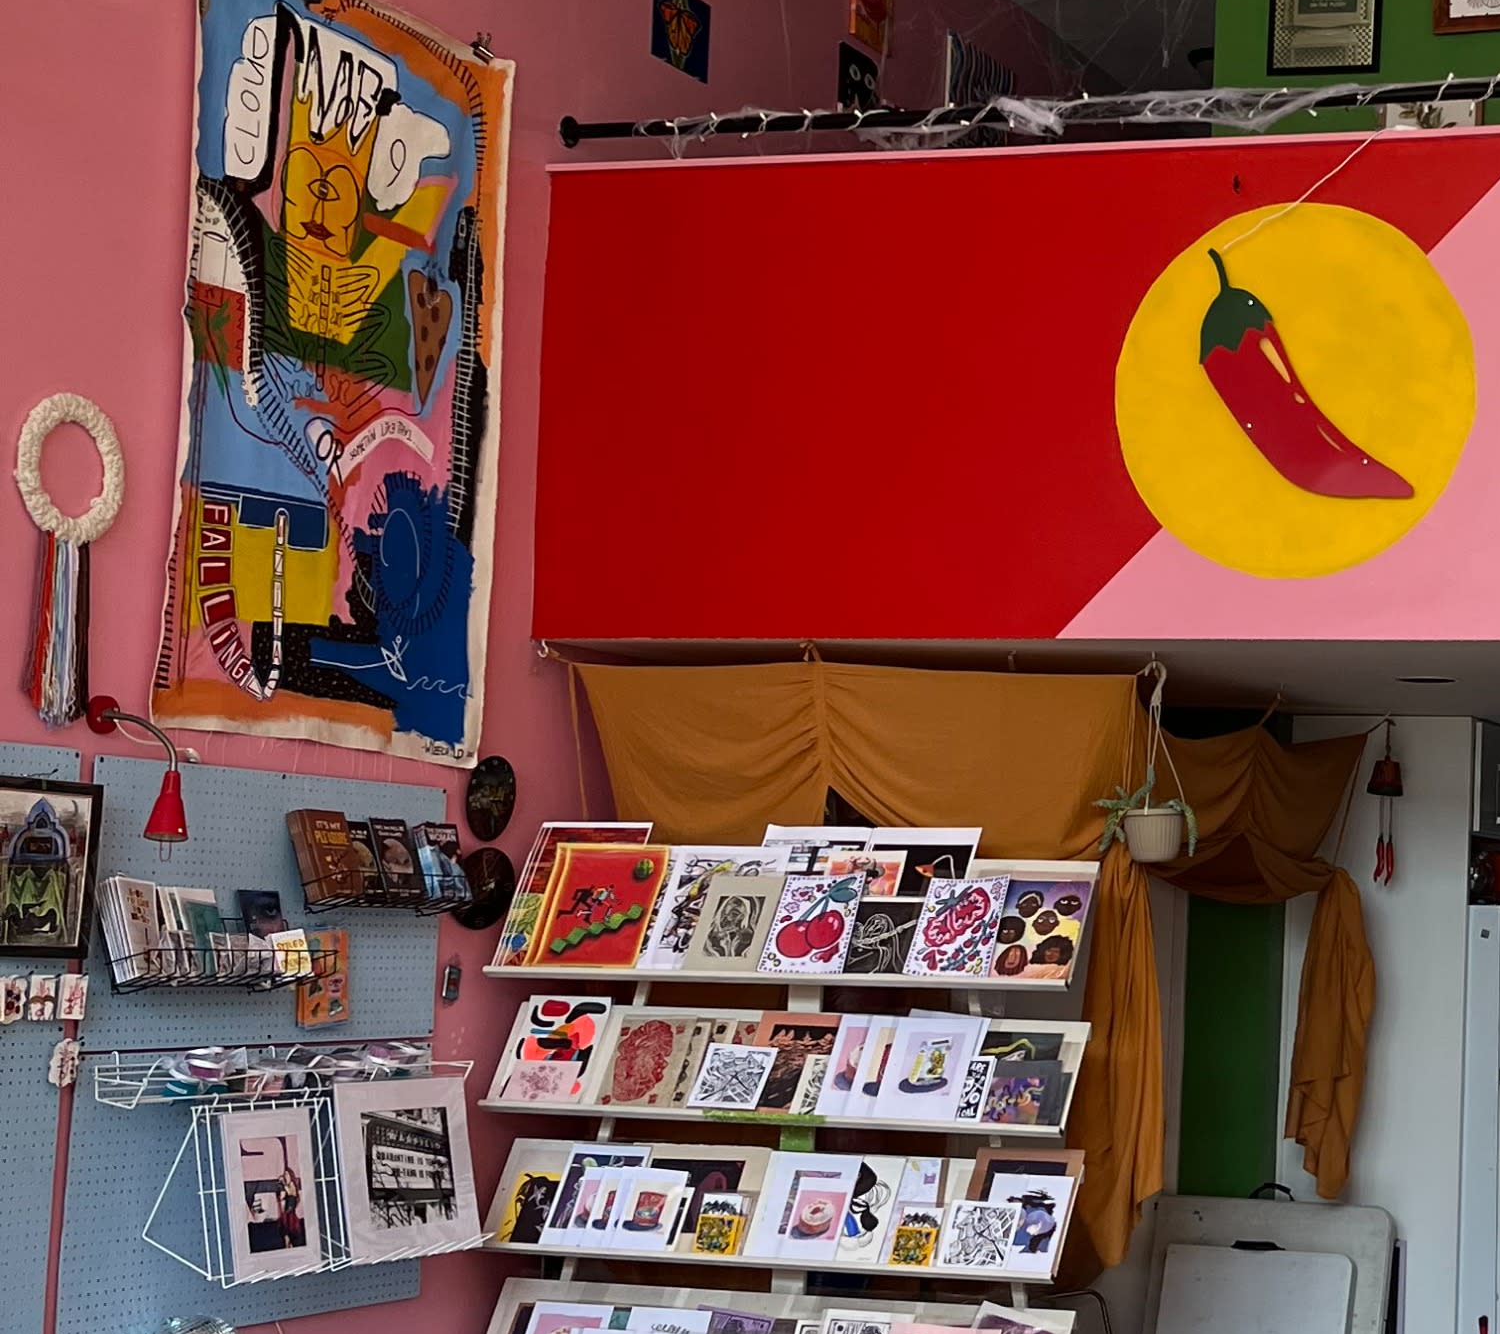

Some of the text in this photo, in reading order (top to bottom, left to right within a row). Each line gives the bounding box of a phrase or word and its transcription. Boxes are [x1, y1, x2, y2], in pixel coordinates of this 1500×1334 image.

[235, 24, 271, 166] CLOUD
[315, 428, 345, 489] OR
[200, 503, 250, 687] FALLING
[330, 822, 341, 830] MY
[428, 833, 458, 843] WOMAN
